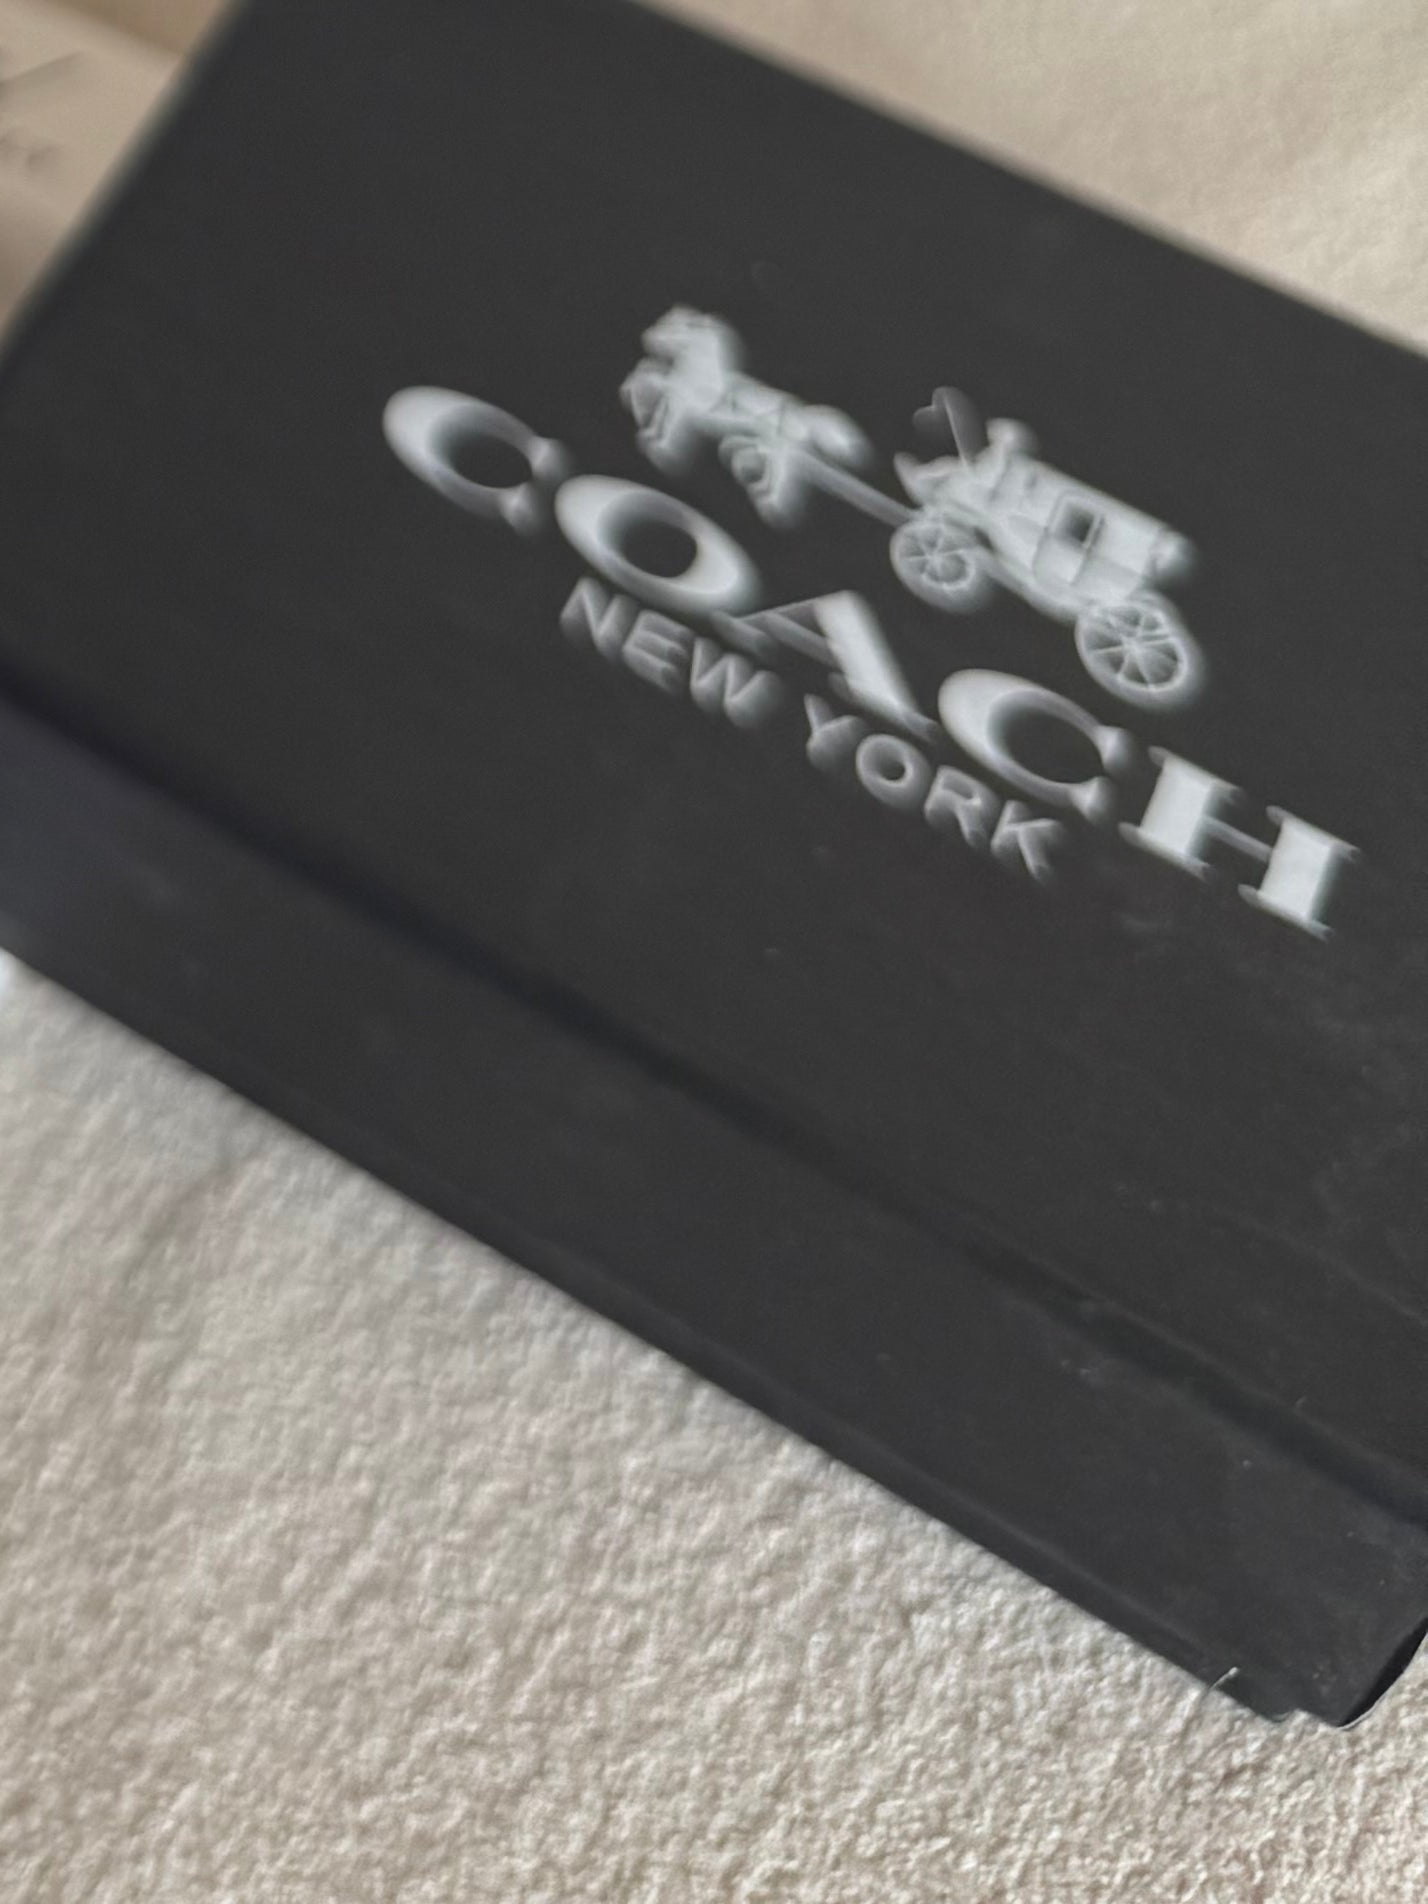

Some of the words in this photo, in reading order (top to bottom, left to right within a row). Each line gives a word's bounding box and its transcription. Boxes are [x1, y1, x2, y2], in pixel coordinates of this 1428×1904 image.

[382, 384, 1360, 942] COACH
[559, 577, 784, 732] NEW
[804, 692, 1068, 886] YORK
